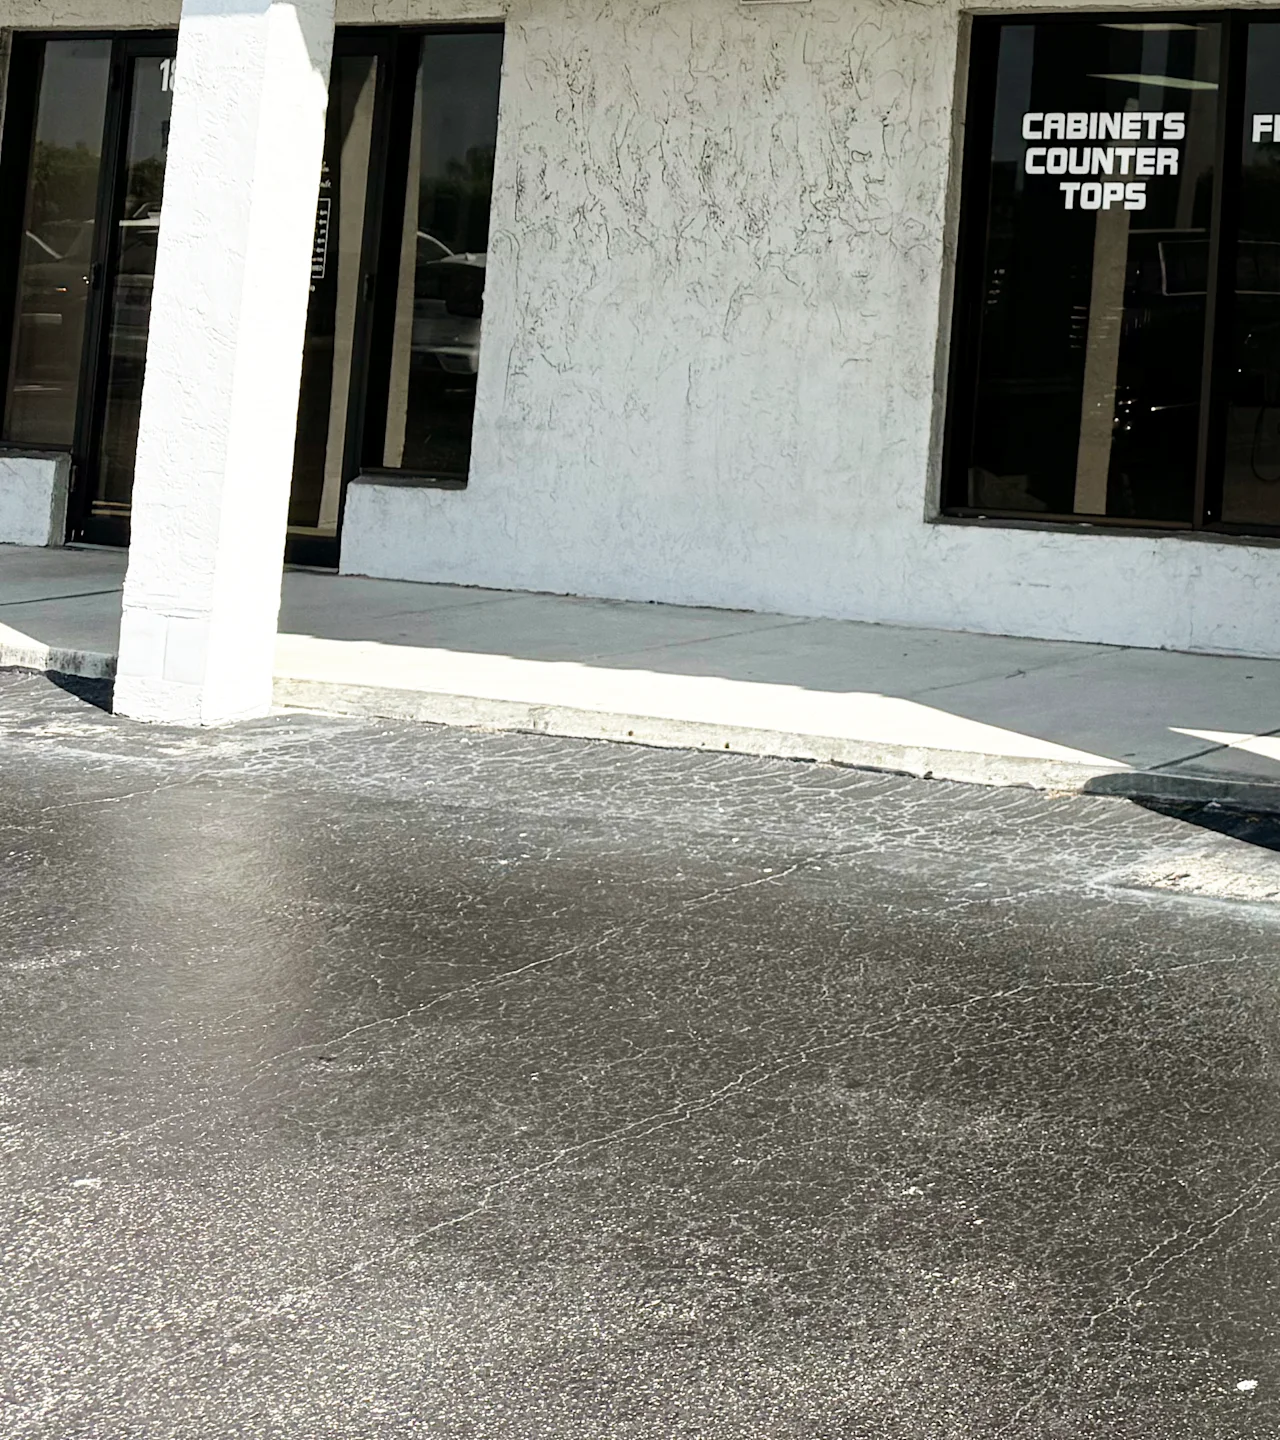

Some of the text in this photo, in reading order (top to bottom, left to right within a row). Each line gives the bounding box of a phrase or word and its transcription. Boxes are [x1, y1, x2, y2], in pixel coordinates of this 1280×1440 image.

[1022, 112, 1185, 140] CABINETS
[1025, 147, 1179, 175] COUNTER
[1059, 182, 1147, 210] TOPS
